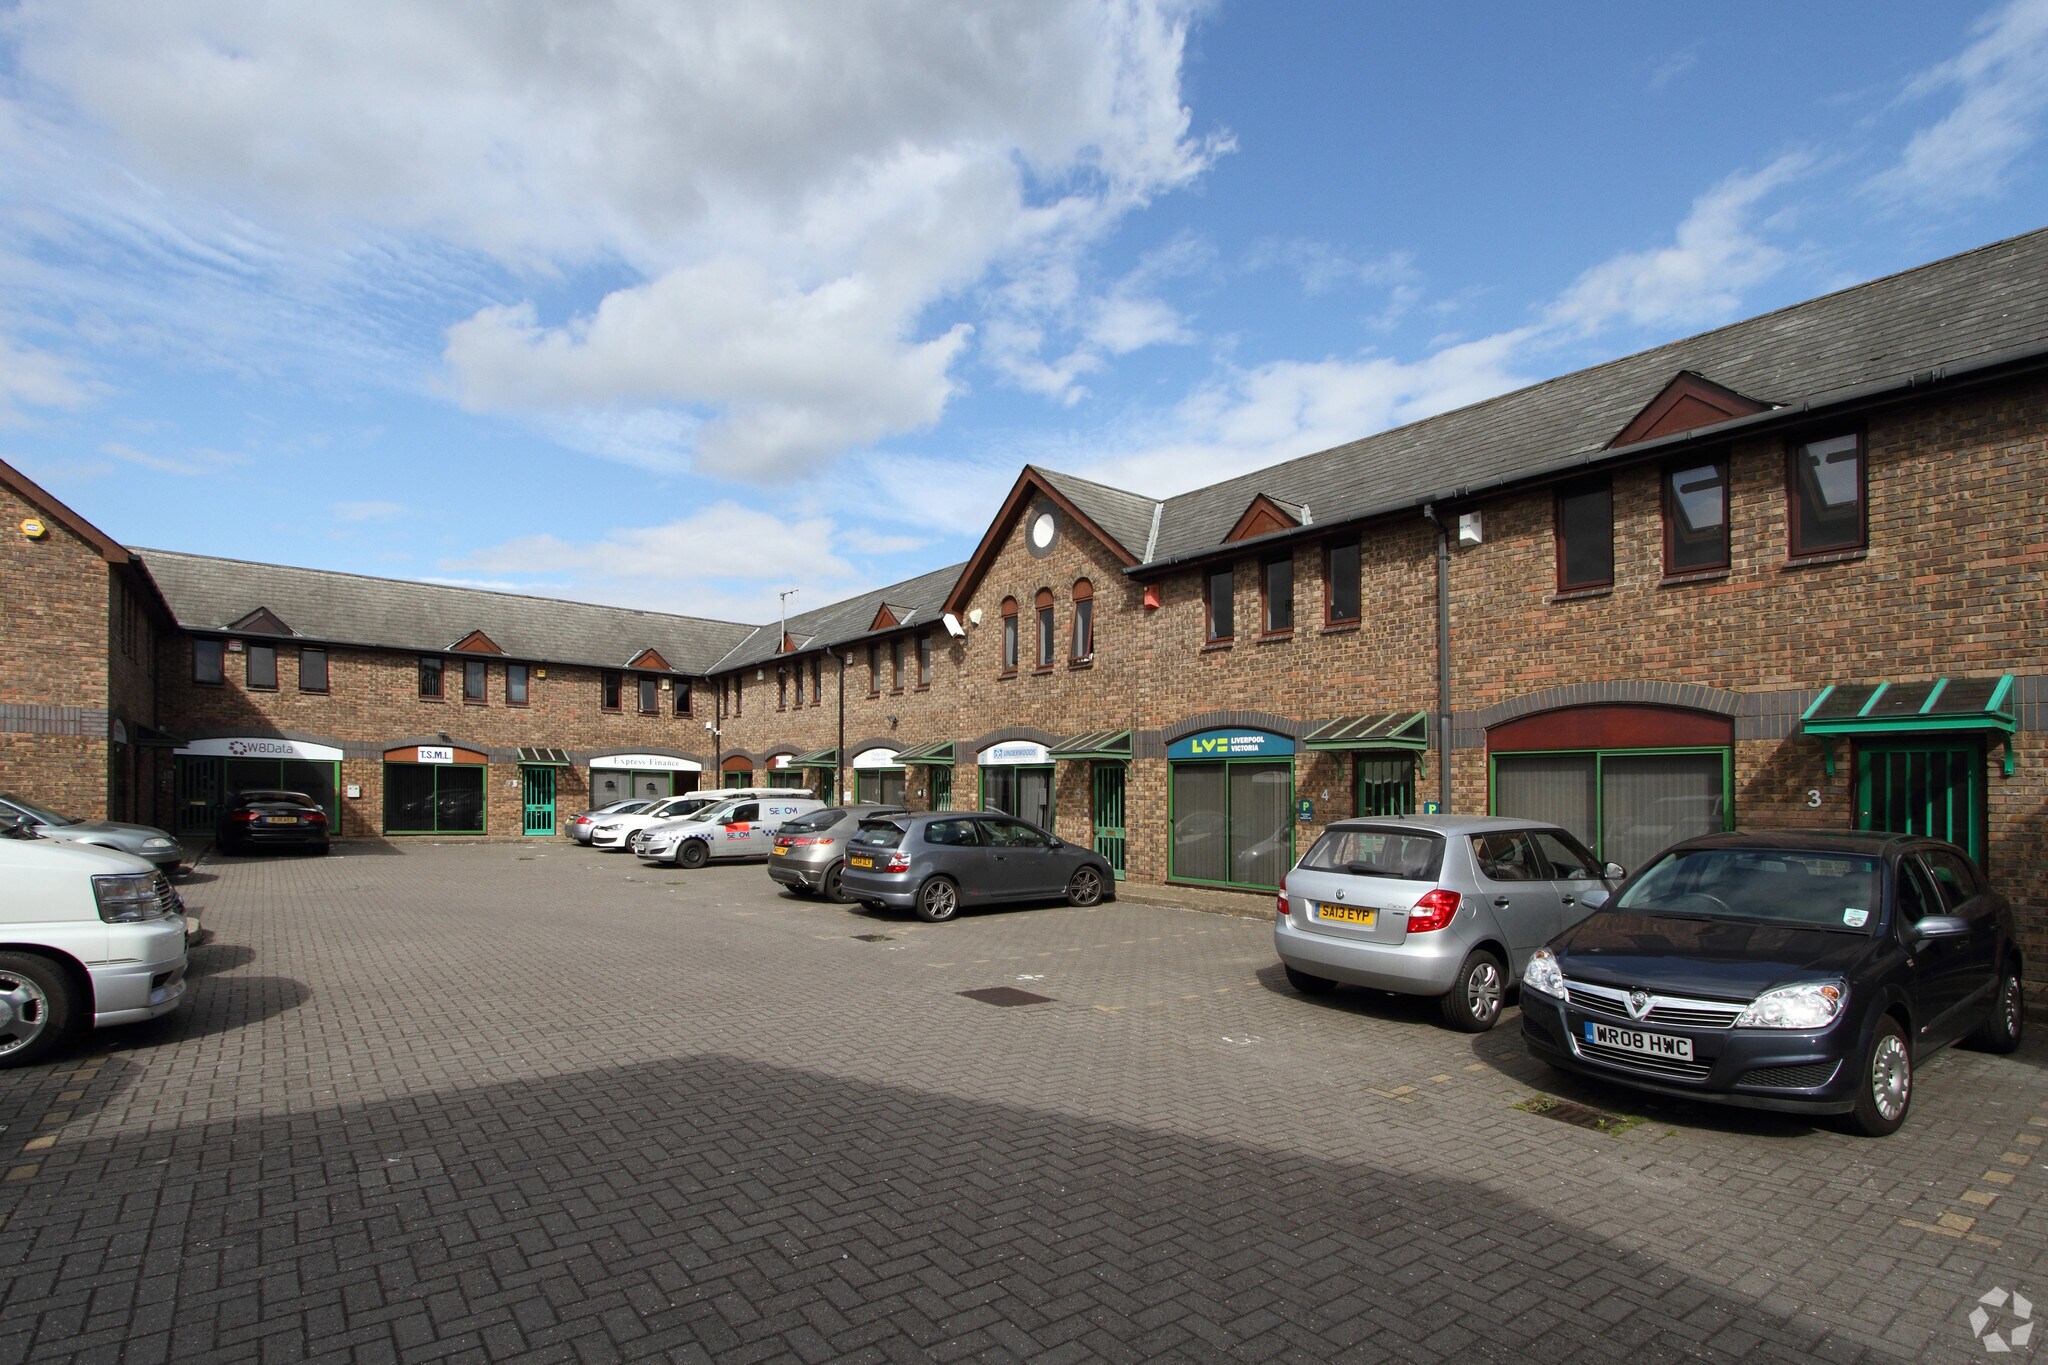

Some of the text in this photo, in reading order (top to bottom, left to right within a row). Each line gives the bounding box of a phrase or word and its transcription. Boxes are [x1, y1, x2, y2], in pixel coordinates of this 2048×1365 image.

[1231, 736, 1265, 744] LIVERPOOL
[247, 743, 294, 754] W8Data
[1003, 748, 1036, 757] UNDERWOODS
[1231, 744, 1259, 752] VICTORIA
[420, 750, 452, 759] T.S.M.L.
[613, 757, 680, 767] Express Finance
[1321, 789, 1330, 801] 4
[1807, 789, 1821, 807] 3
[1303, 801, 1309, 811] P
[1429, 804, 1437, 814] P
[1322, 904, 1370, 922] SA13 EYP
[1597, 1026, 1689, 1056] WR08 HWC
